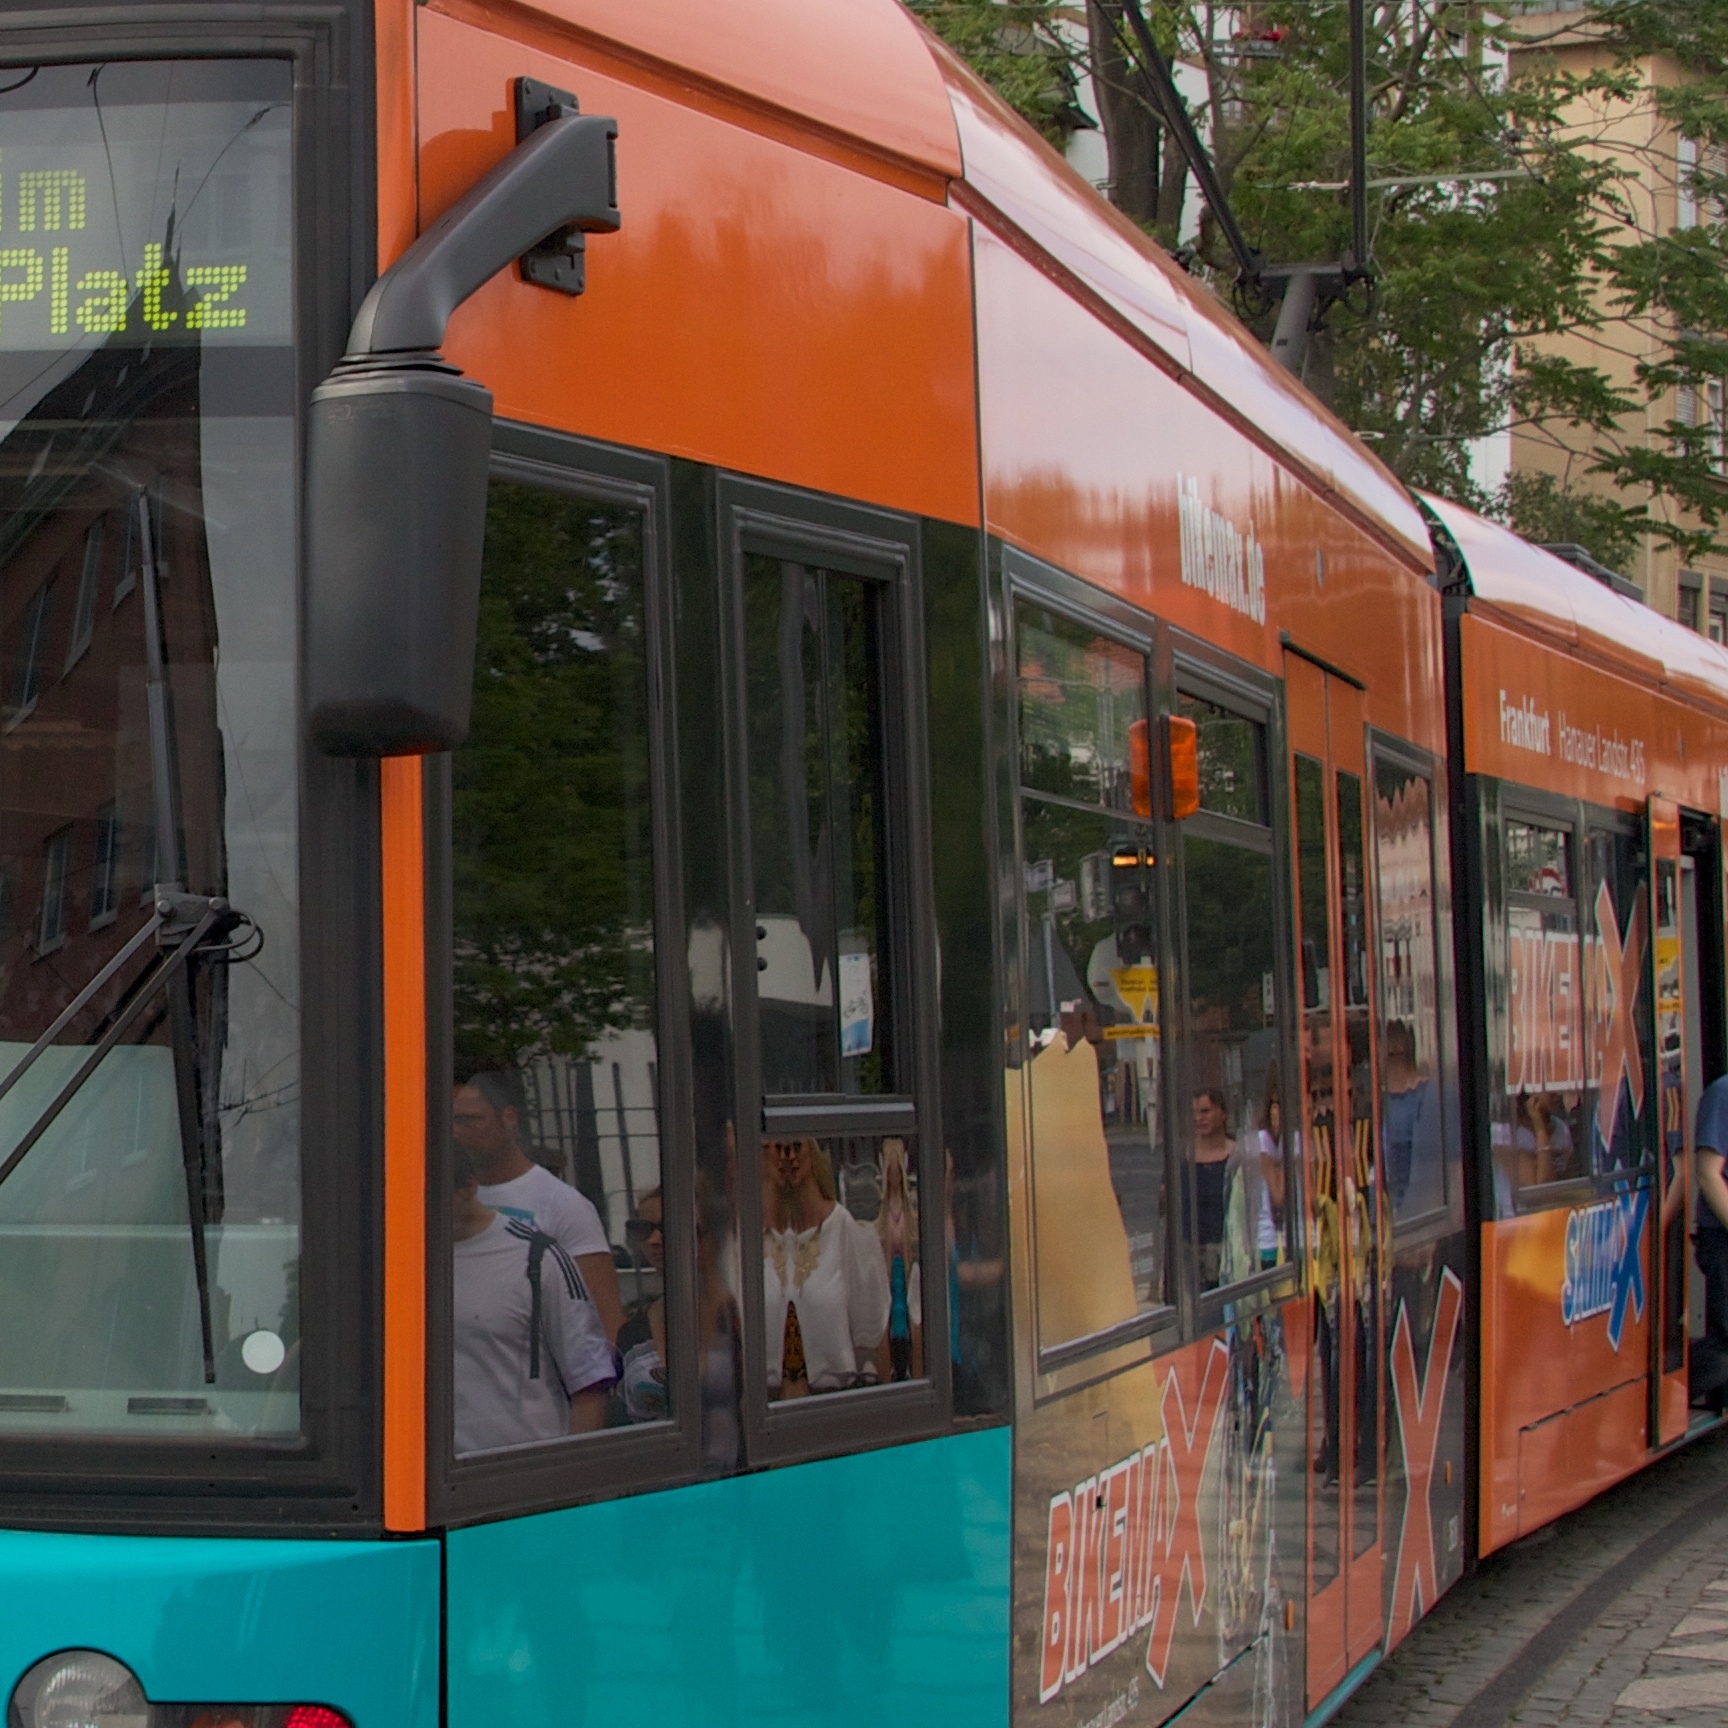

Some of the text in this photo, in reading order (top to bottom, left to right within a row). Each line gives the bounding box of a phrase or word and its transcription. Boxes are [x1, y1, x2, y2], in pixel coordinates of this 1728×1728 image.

[1176, 471, 1266, 627] bikemax.de
[1499, 688, 1552, 757] Frankfurt
[1505, 878, 1649, 1153] BIKEMAX
[1039, 1336, 1228, 1705] BIKEMAX
